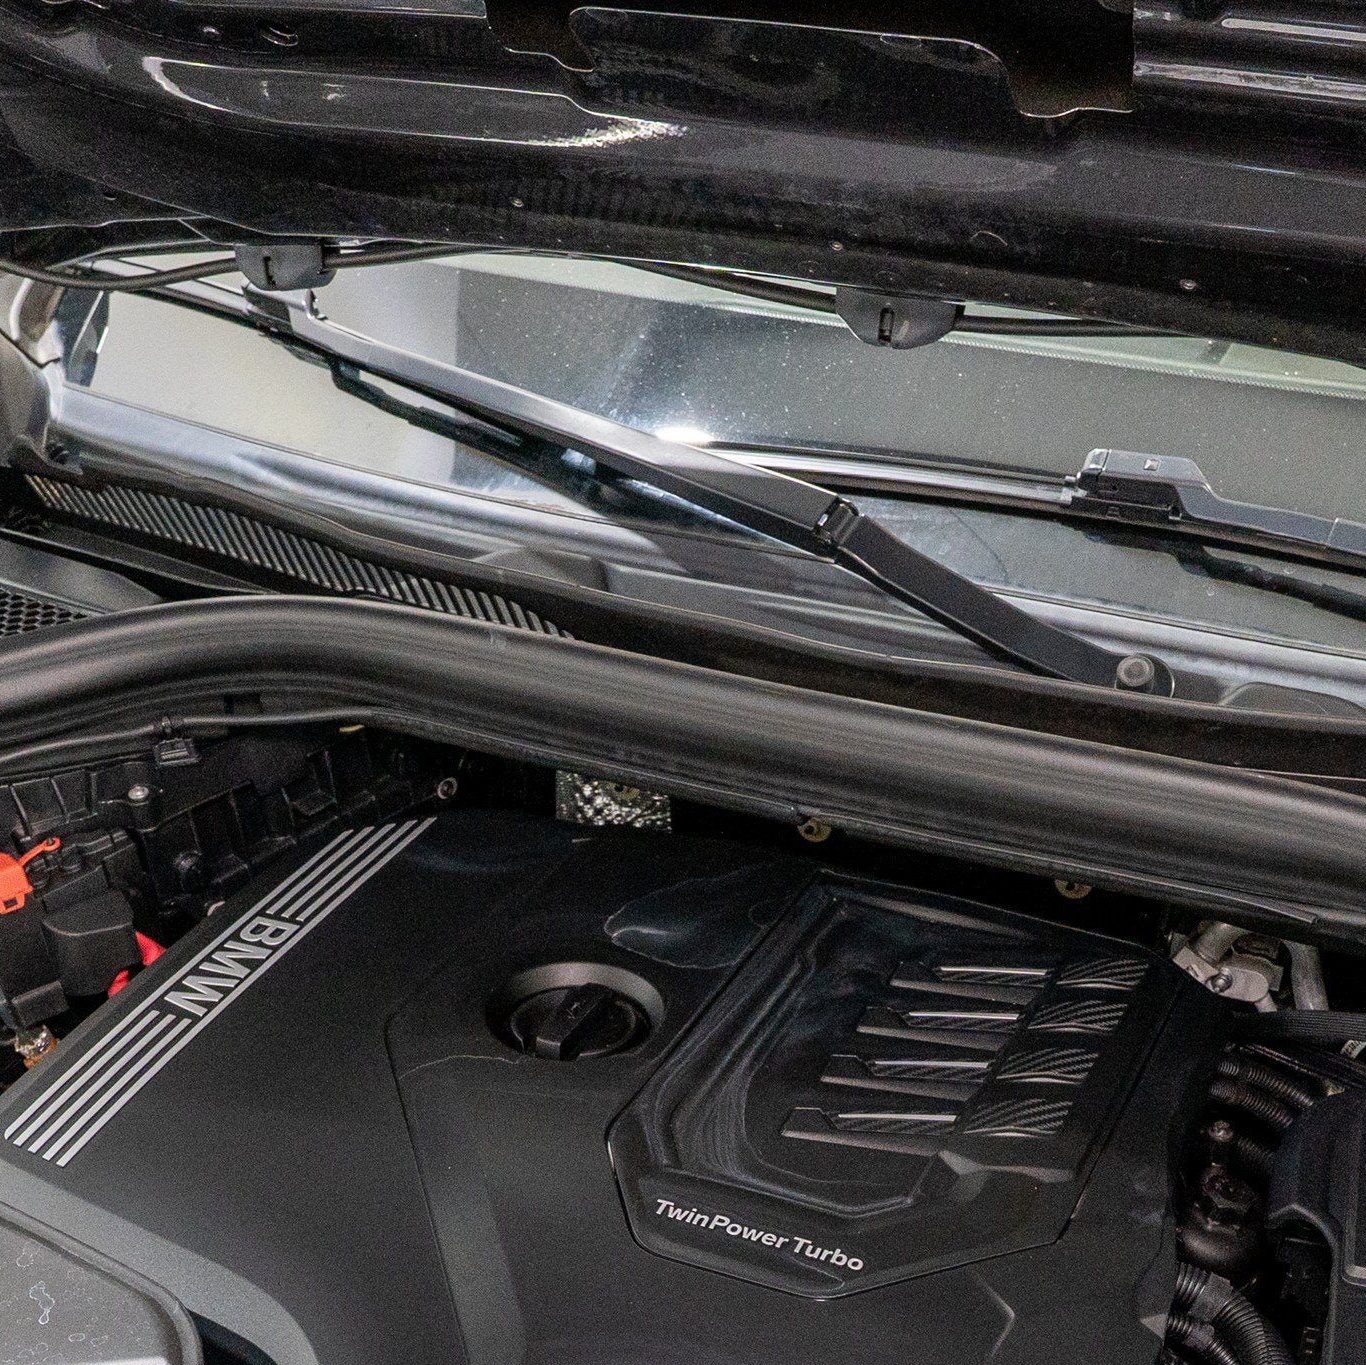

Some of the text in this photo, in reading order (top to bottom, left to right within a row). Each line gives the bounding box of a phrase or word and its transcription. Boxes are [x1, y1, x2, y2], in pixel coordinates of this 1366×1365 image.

[164, 916, 300, 1017] BMW
[655, 1199, 864, 1271] TwinPower Turbo
